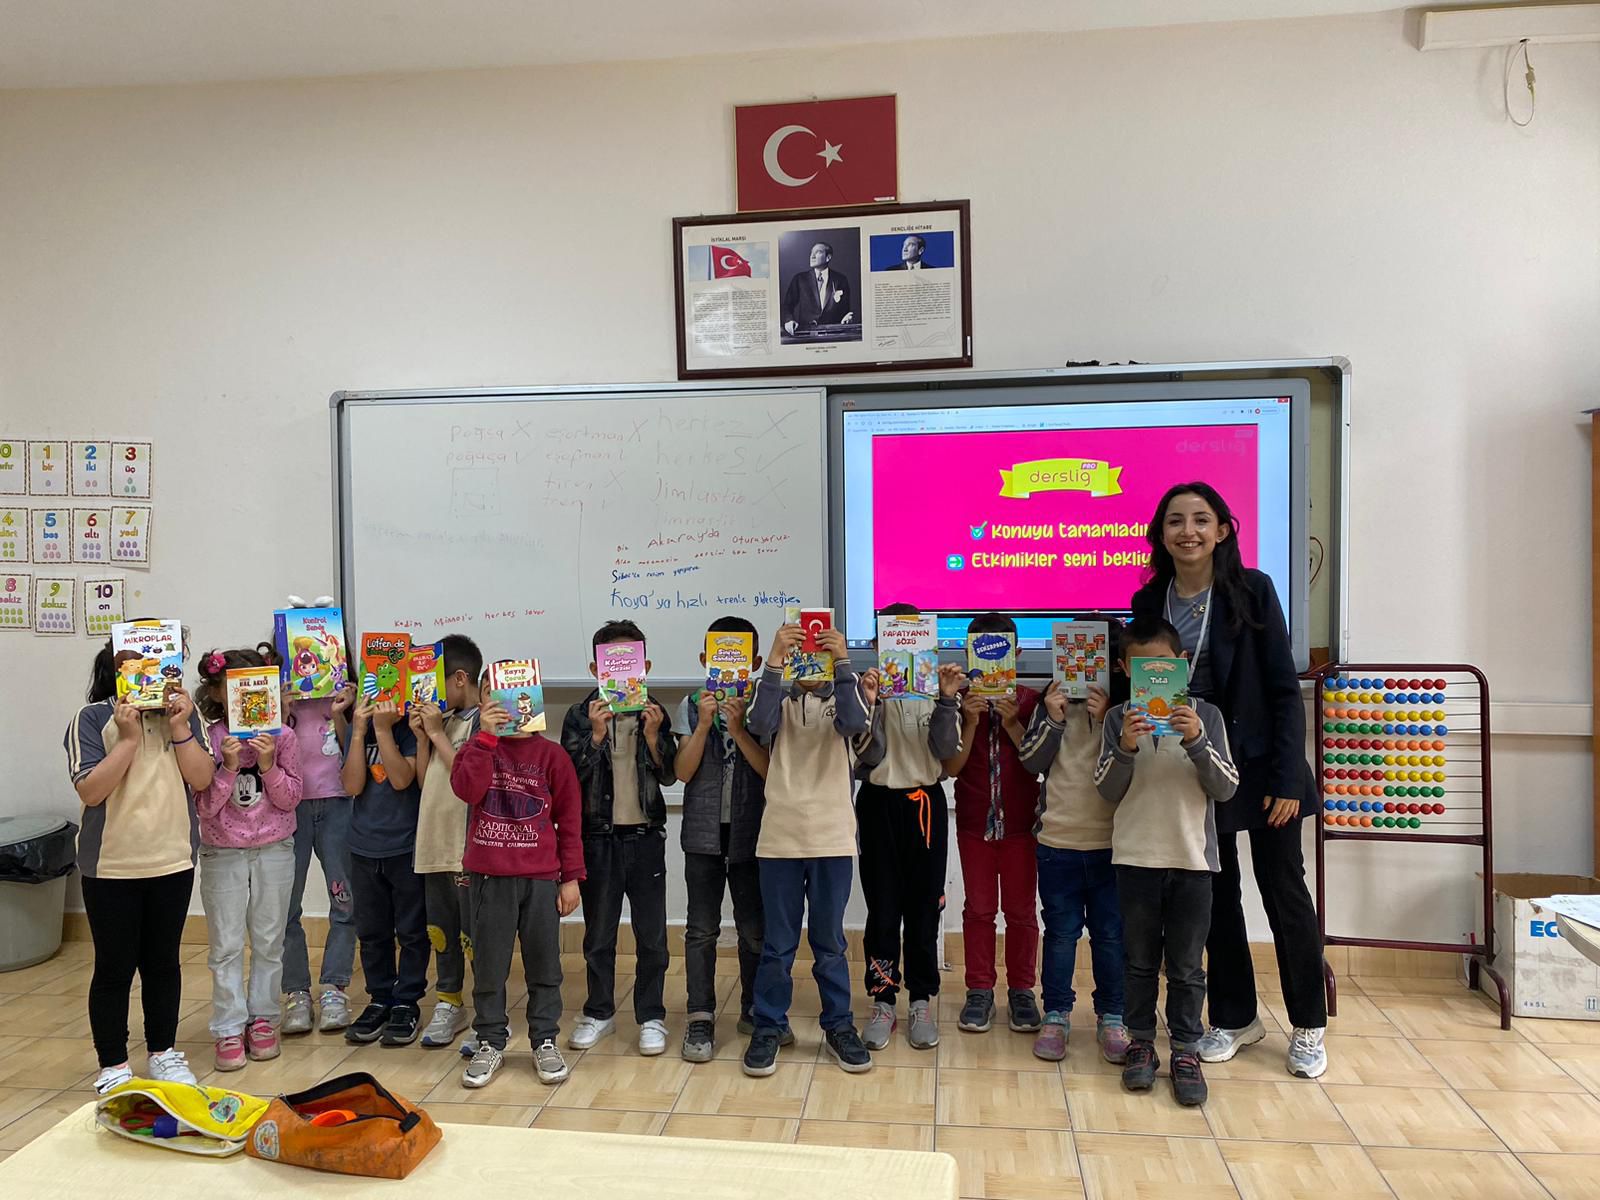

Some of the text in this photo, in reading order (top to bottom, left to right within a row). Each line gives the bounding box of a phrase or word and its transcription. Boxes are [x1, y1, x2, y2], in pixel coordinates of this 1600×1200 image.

[0, 443, 12, 459] 0
[43, 445, 51, 459] 1
[85, 445, 97, 460] 2
[125, 447, 137, 461] 3
[42, 461, 54, 472] bir
[1029, 469, 1091, 487] derslig
[2, 511, 14, 526] 4
[45, 513, 56, 527] 5
[87, 513, 98, 527] 6
[125, 511, 136, 525] 7
[43, 528, 59, 539] beş
[119, 529, 139, 538] yedi
[991, 523, 1054, 540] Konuyu
[971, 551, 1058, 568] Etkinlikler
[1063, 550, 1097, 567] seni
[5, 578, 17, 592] 8
[49, 582, 61, 597] 9
[94, 584, 114, 599] 10
[41, 599, 67, 609] dokuz
[98, 603, 111, 611] on
[123, 634, 173, 645] MİKROPLAR
[882, 629, 930, 637] PAPATYANIN
[366, 637, 405, 650] Lütfen de
[896, 637, 917, 645] SÖZÜ
[503, 668, 527, 676] Kayıp
[511, 776, 539, 787] APPAREL
[478, 819, 536, 833] RADITIONAL
[475, 829, 539, 841] ANDCRAFTED
[1530, 920, 1563, 938] EC
